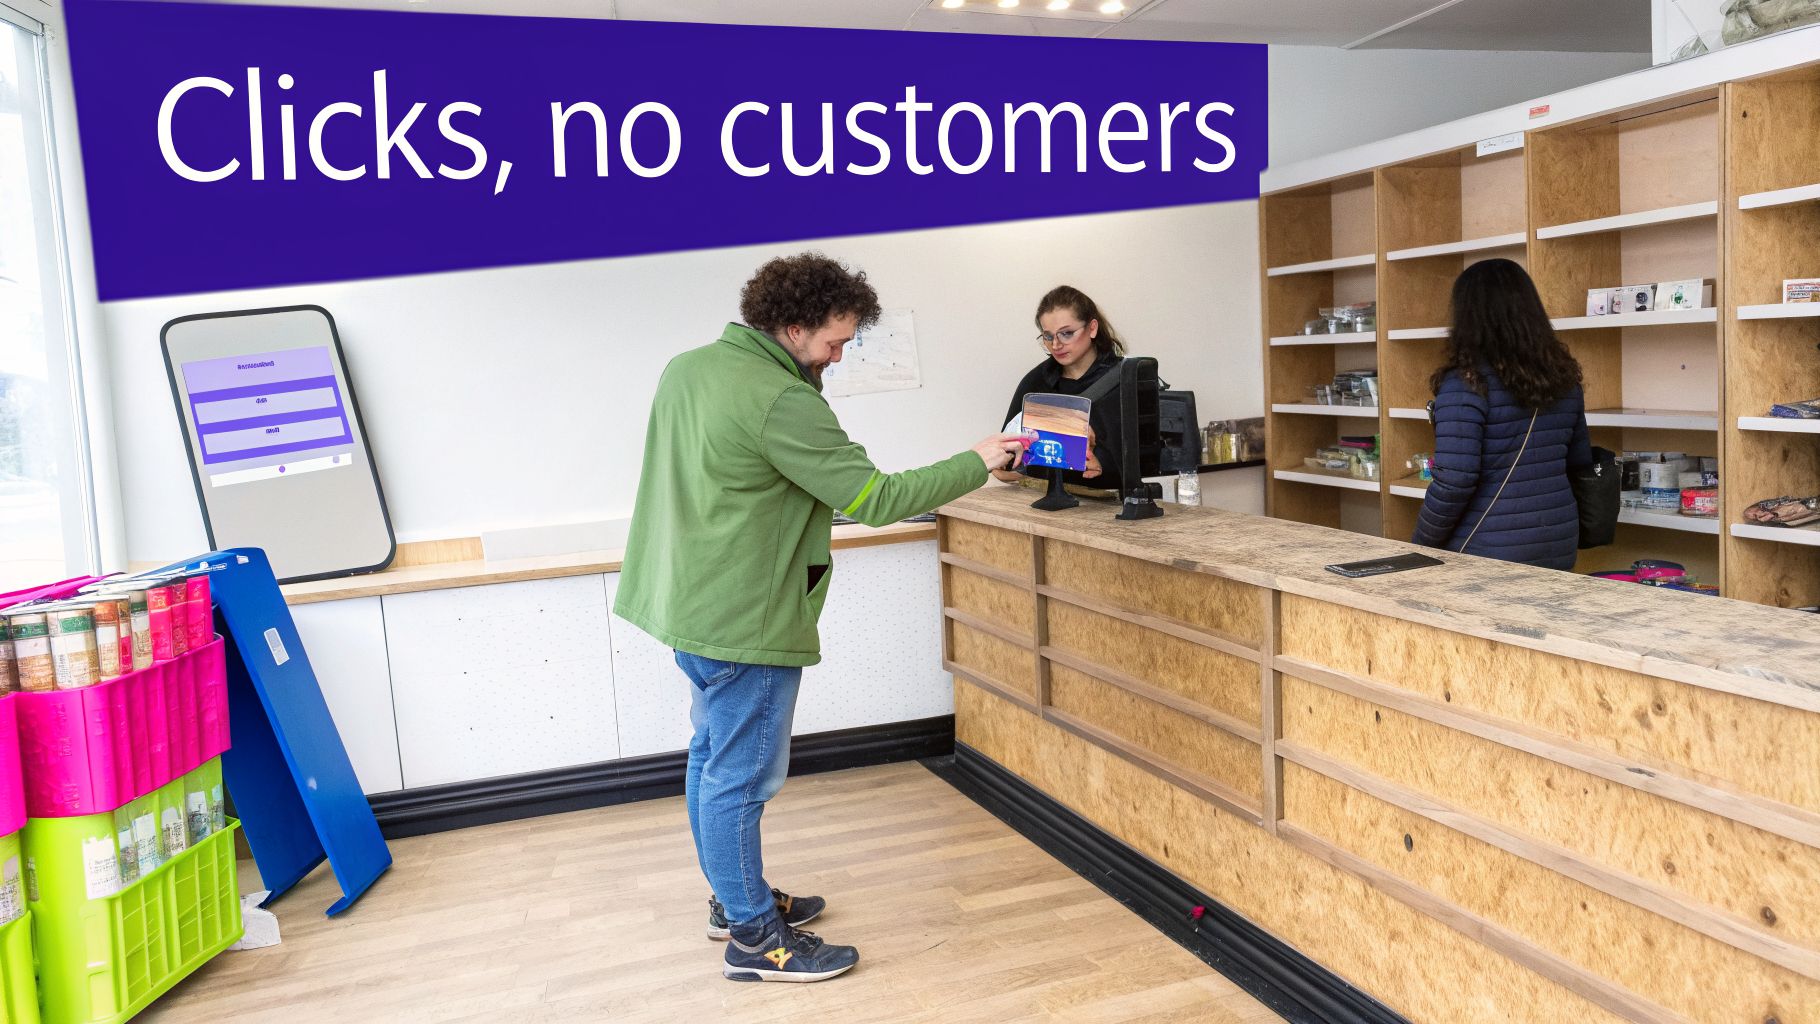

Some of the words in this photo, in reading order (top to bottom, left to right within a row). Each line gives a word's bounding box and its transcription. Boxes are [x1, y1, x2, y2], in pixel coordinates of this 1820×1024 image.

[157, 66, 513, 196] Clicks,
[550, 101, 682, 178] no
[720, 85, 1236, 178] customers
